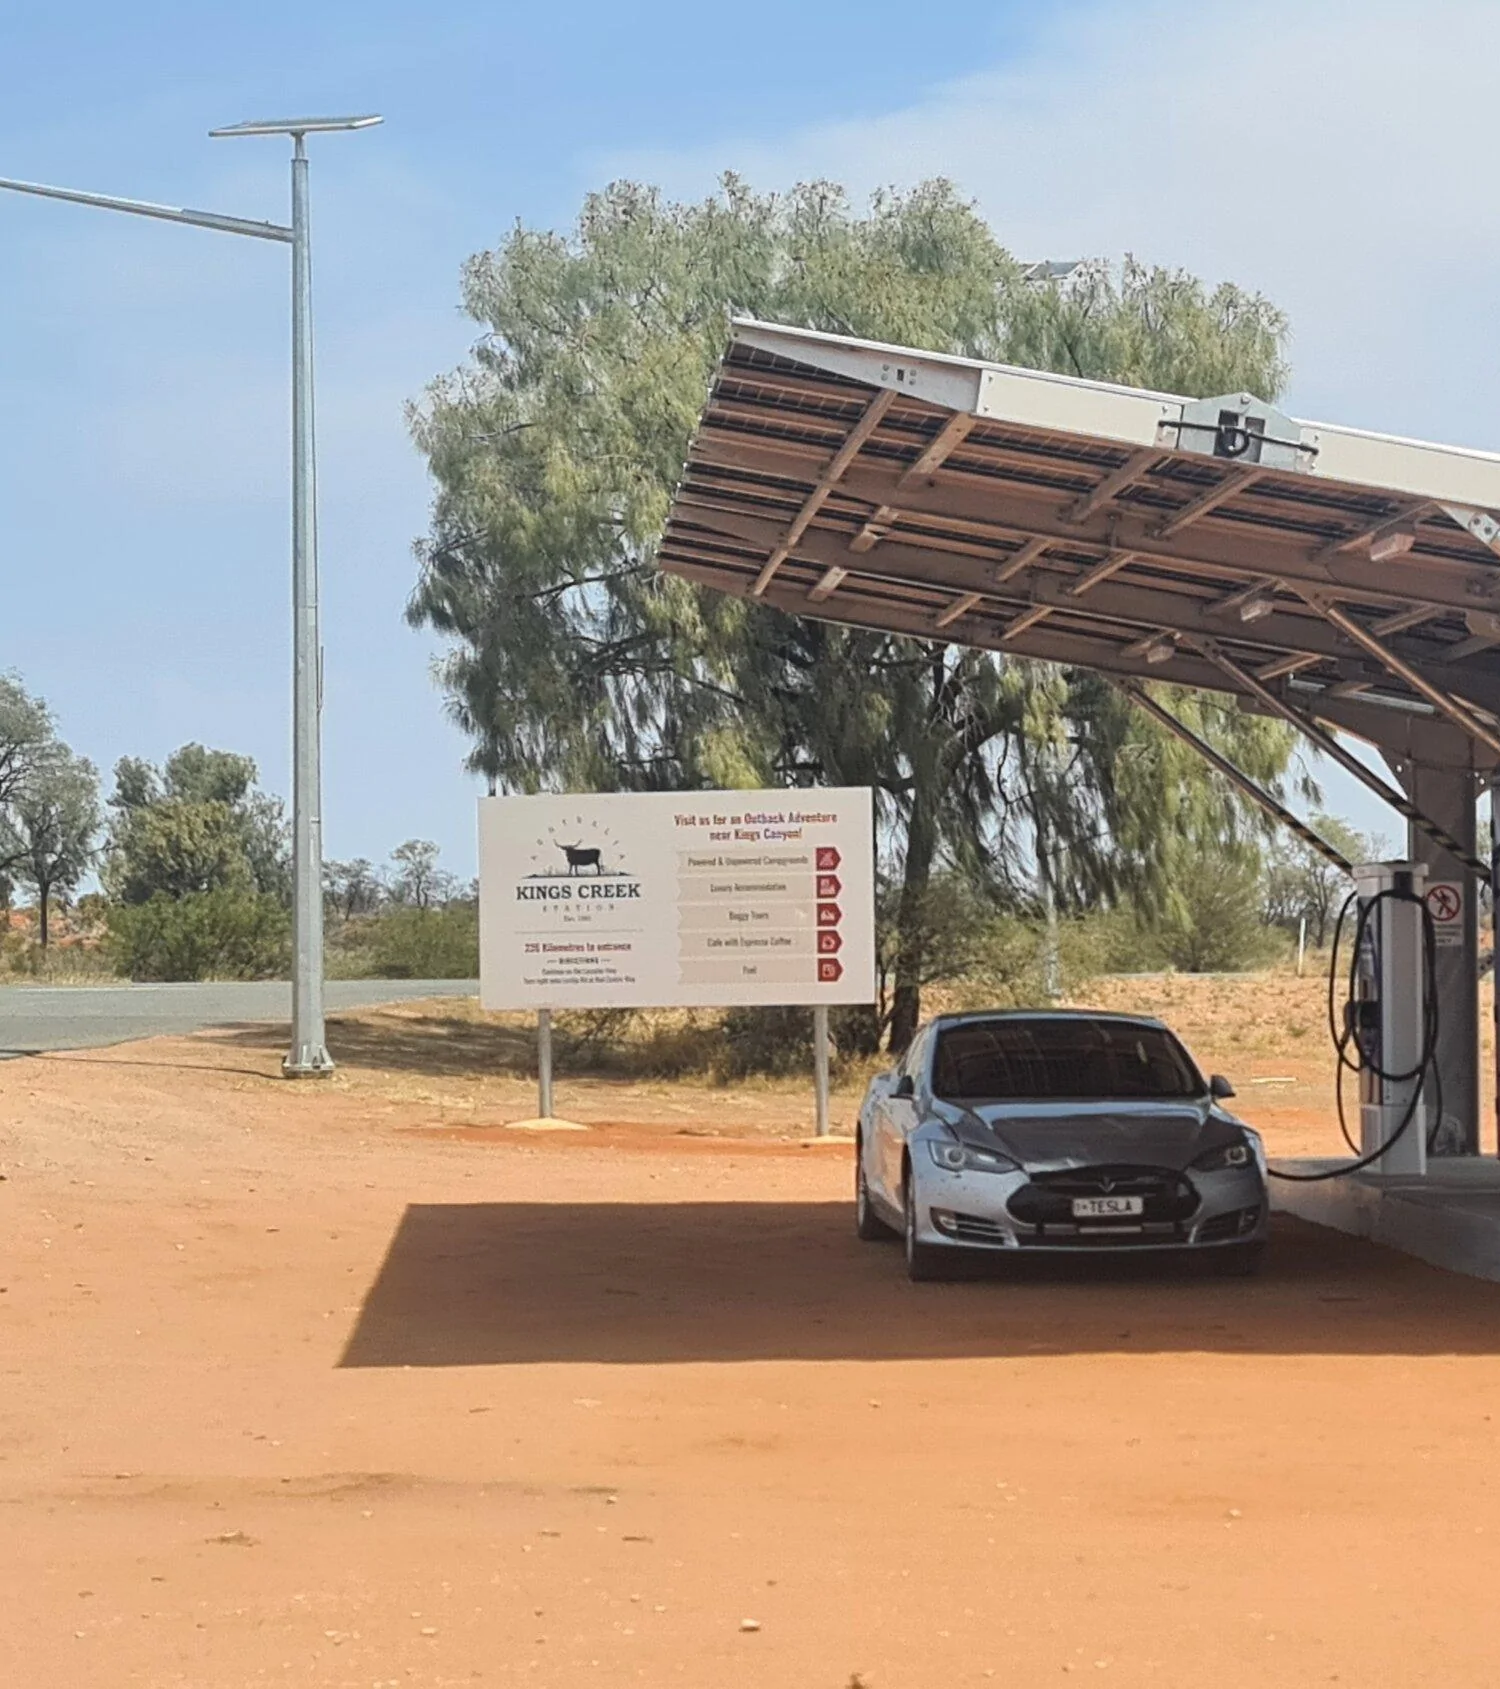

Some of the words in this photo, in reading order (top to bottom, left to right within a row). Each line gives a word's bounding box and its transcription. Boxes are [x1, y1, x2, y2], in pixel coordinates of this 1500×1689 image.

[674, 815, 696, 826] Visit
[699, 816, 710, 826] us
[713, 814, 726, 825] for
[730, 815, 742, 825] an
[744, 812, 785, 825] Outback
[788, 811, 838, 824] Adventure
[709, 830, 731, 841] near
[734, 828, 761, 842] Kings
[763, 827, 803, 841] Canyon!
[688, 856, 716, 867] Powered
[718, 856, 724, 866] &
[726, 856, 761, 868] Unpowered
[763, 855, 809, 867] Campgrounds
[516, 885, 572, 900] KINGS
[577, 883, 641, 899] CREEK
[734, 881, 787, 892] Accommodation
[542, 903, 615, 913] STATION
[751, 910, 769, 920] Tours
[724, 937, 739, 947] with
[770, 936, 792, 947] Coffee
[542, 942, 585, 953] Kilometres
[586, 942, 595, 952] to
[597, 942, 632, 952] entrance
[742, 965, 757, 975] Fuel
[1089, 1199, 1134, 1214] TESLA
